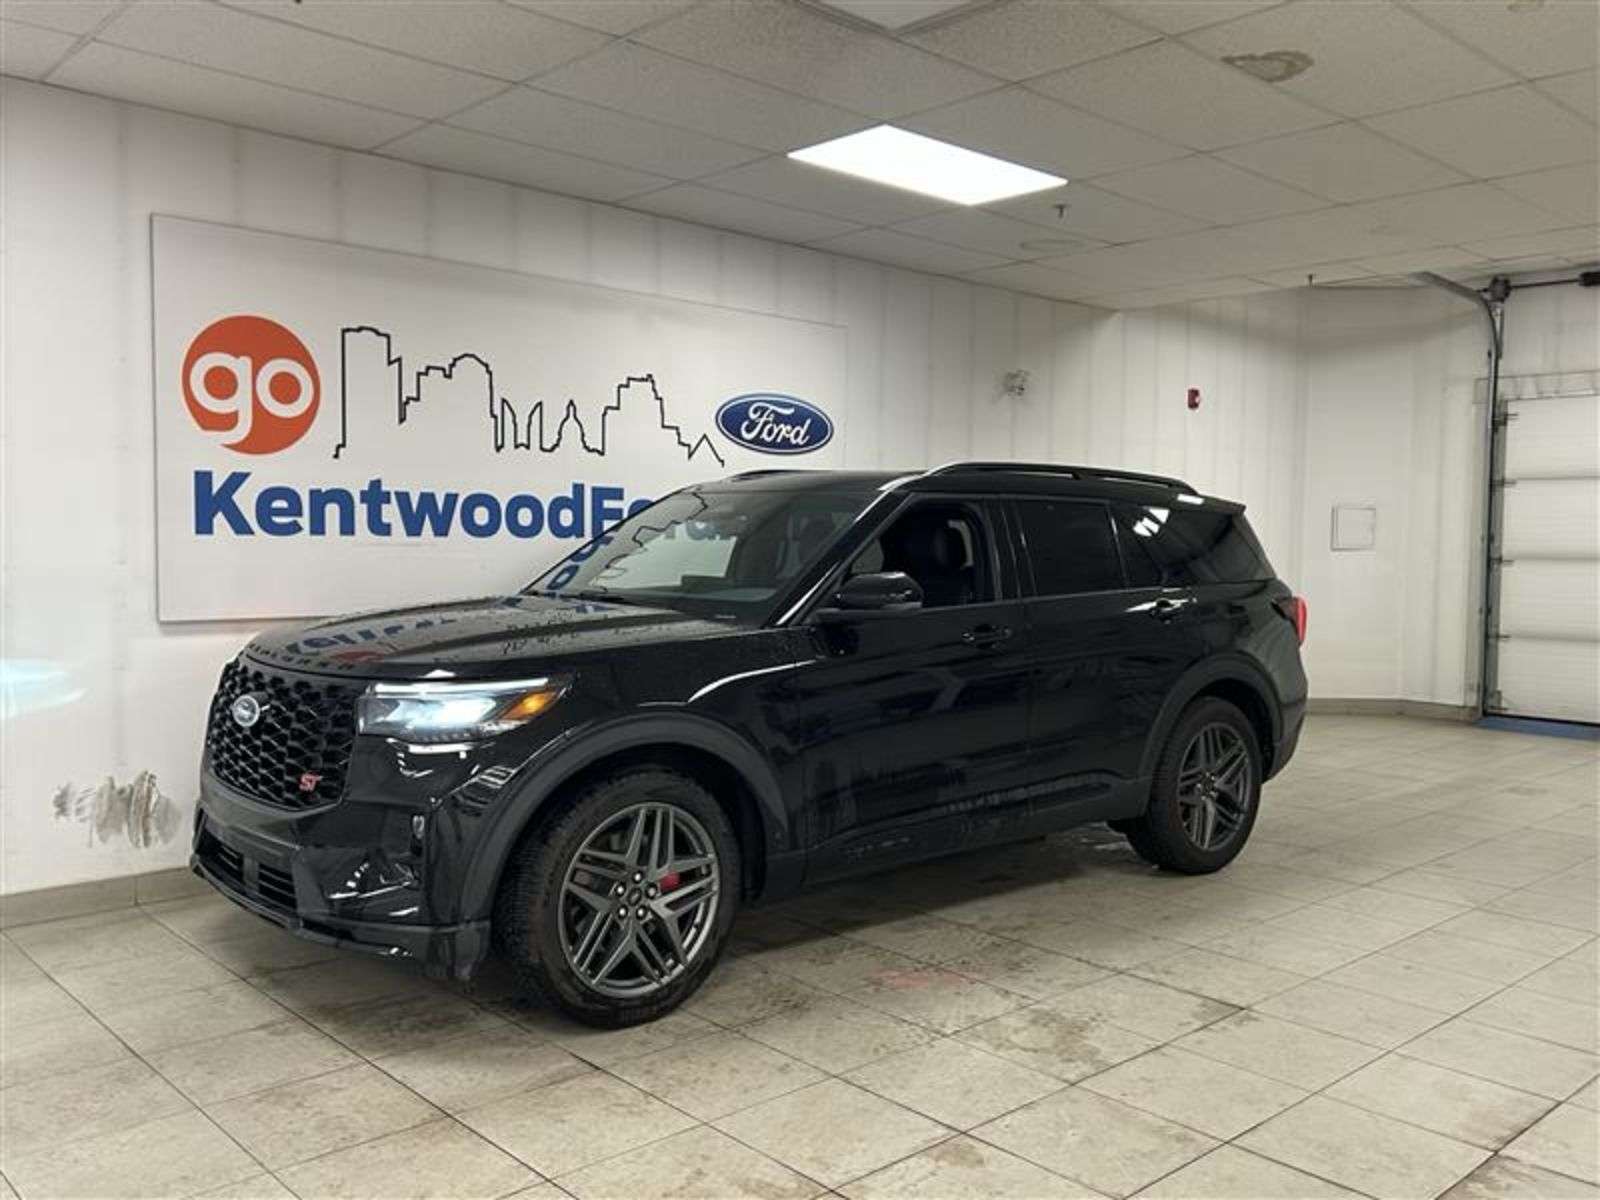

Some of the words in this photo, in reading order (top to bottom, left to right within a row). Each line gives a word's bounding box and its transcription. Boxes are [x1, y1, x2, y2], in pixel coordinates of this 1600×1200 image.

[189, 351, 315, 446] go
[740, 401, 812, 446] Ford
[193, 469, 656, 541] KentwoodF
